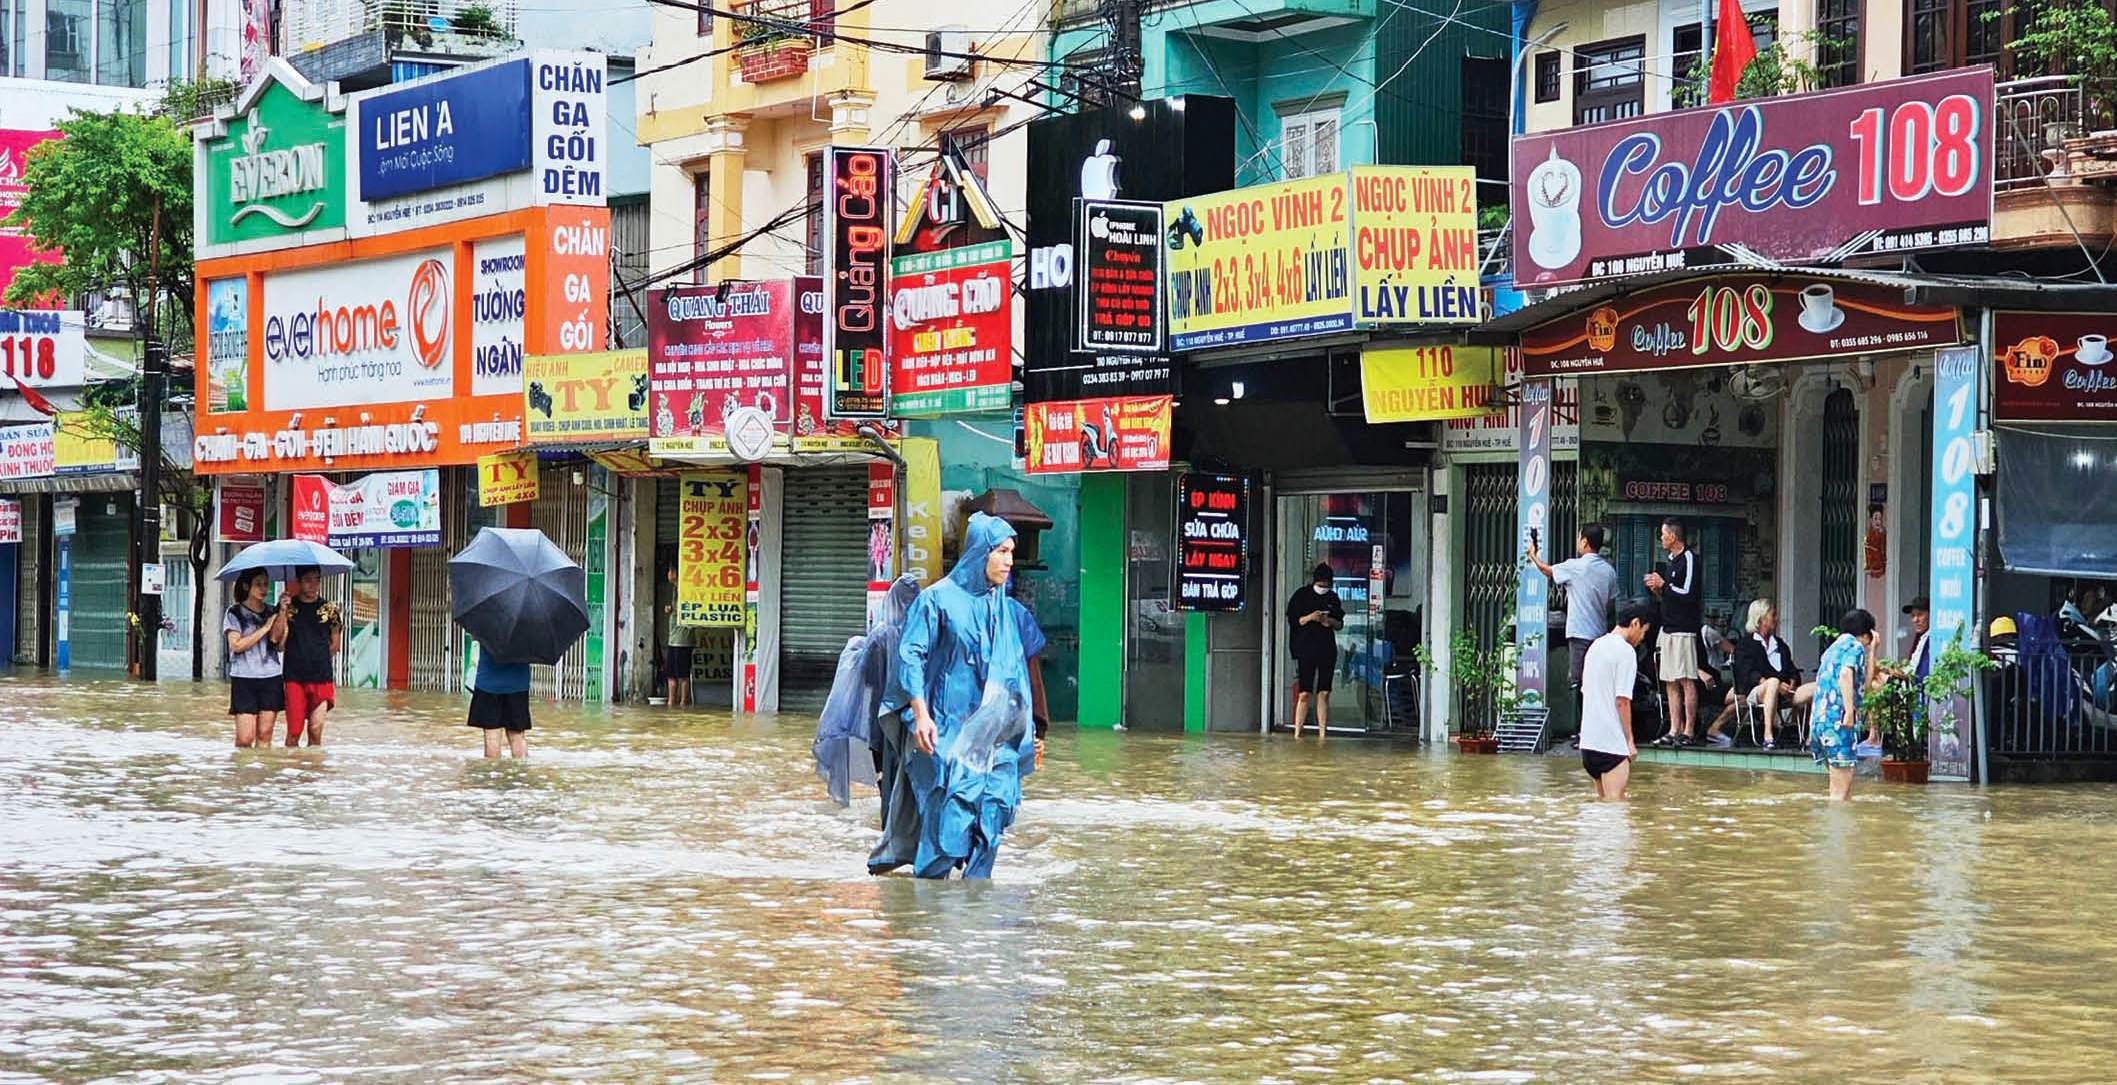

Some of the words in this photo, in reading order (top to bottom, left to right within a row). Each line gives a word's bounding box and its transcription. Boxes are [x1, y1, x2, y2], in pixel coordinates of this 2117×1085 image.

[540, 61, 601, 93] CHĂN
[553, 101, 589, 127] GA
[548, 130, 594, 161] GỐI
[231, 143, 326, 204] EVERON
[543, 166, 600, 199] ĐỆM
[1597, 105, 1837, 247] Coffee
[1850, 94, 1980, 206] 108
[837, 154, 877, 220] Cáo
[1356, 176, 1406, 220] NGỌC
[1412, 170, 1455, 213] VĨNH
[1460, 178, 1472, 213] 2
[1207, 200, 1264, 244] NGỌC
[1271, 188, 1322, 231] VĨNH
[1331, 186, 1344, 222] 2
[554, 221, 604, 255] CHĂN
[1109, 230, 1133, 244] HOÀI
[1134, 234, 1156, 246] LINH
[1358, 226, 1421, 279] CHỤP
[1428, 215, 1475, 270] ẢNH
[481, 255, 524, 274] SHOWROOM
[1607, 260, 1624, 274] 108
[1626, 250, 1664, 273] NGUYỄN
[564, 274, 591, 303] GA
[838, 226, 883, 332] Quảng
[962, 270, 1001, 314] CÁO
[1171, 267, 1191, 329] CHỤP
[1194, 252, 1212, 316] ẢNH
[1214, 256, 1242, 317] 2x3,
[1246, 252, 1274, 312] 3x4,
[1277, 246, 1302, 305] 4x6
[1305, 233, 1322, 302] LẤY
[1325, 231, 1347, 299] LIỀN
[473, 280, 524, 322] TƯỜNG
[669, 293, 726, 321] QUANG
[729, 286, 770, 315] THÁI
[1361, 273, 1408, 318] LẤY
[1418, 275, 1476, 318] LIỀN
[24, 312, 60, 334] KHOA
[266, 296, 397, 360] everhome
[560, 309, 593, 349] GỐI
[1632, 323, 1686, 356] Coffee
[1688, 282, 1775, 355] 108
[1, 336, 55, 379] 118
[477, 336, 522, 375] NGÂN
[1841, 337, 1856, 348] 0355
[386, 361, 401, 376] hoa
[836, 349, 883, 391] LED
[1416, 345, 1453, 378] 110
[1939, 354, 1973, 380] Coffee
[554, 370, 619, 412] TÝ
[1372, 377, 1454, 414] NGUYỄN
[1523, 384, 1548, 405] Coffee
[2063, 369, 2117, 392] Coffee
[243, 432, 268, 459] GA
[385, 405, 438, 453] QUỐC
[8, 441, 37, 458] ĐỒNG
[388, 477, 406, 495] GIẢM
[685, 479, 743, 498] TÝ
[1191, 490, 1205, 508] ÉP
[1208, 490, 1236, 509] KÍNH
[1625, 481, 1690, 500] COFFEE
[1696, 483, 1727, 501] 108
[683, 501, 715, 515] CHỤP
[719, 499, 743, 514] ẢNH
[0, 529, 17, 540] Pin
[683, 515, 742, 540] 2x3
[1184, 518, 1207, 537] SỬA
[1211, 521, 1239, 539] CHỮA
[683, 540, 741, 564] 3x4
[1185, 550, 1205, 567] LẤY
[1209, 553, 1236, 568] NGAY
[683, 565, 741, 588] 4x6
[1182, 580, 1200, 598] BÁN
[1202, 580, 1219, 599] TRẢ
[1221, 582, 1238, 599] GÓP
[681, 600, 702, 611] ÉP
[681, 613, 741, 621] PLASTIC
